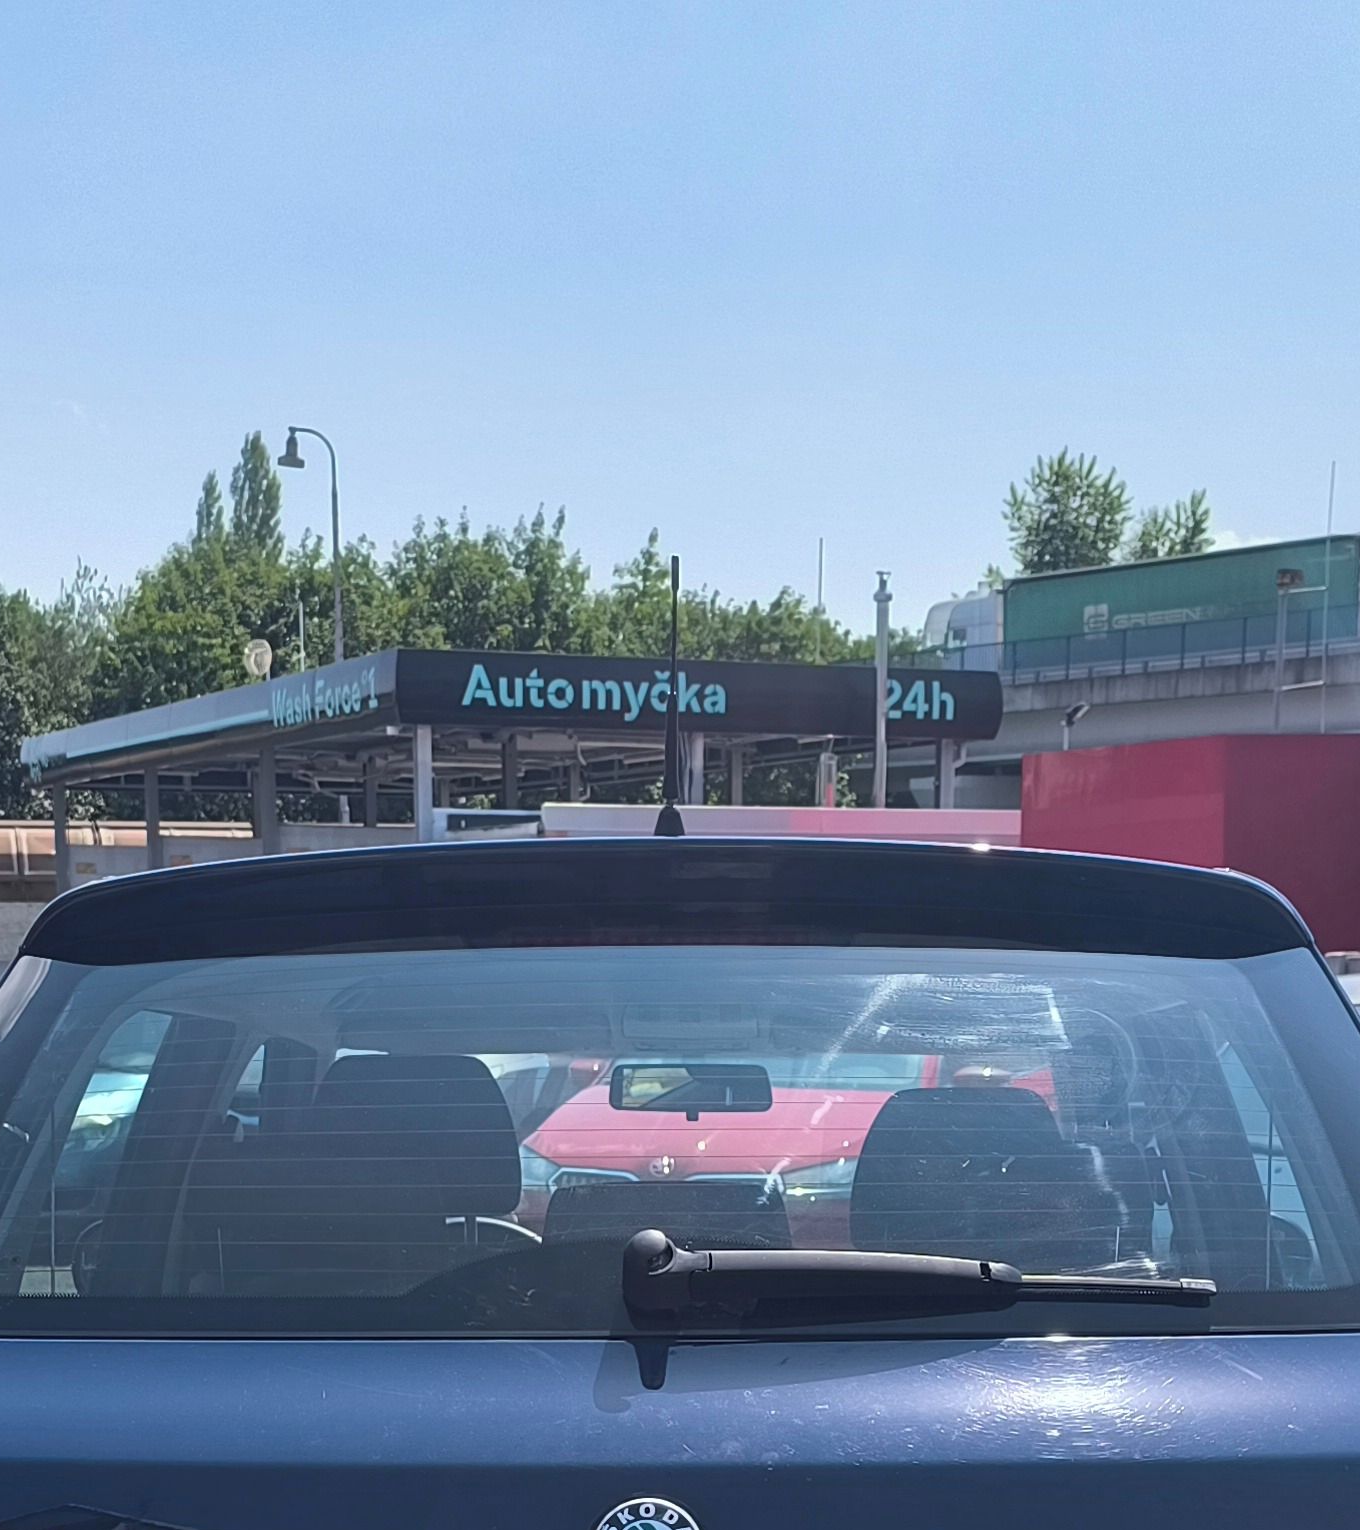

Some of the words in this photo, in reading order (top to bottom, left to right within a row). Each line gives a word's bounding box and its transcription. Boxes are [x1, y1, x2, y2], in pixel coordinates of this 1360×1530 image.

[271, 682, 312, 729] Wash
[315, 679, 361, 720] Force
[885, 679, 955, 720] 24h
